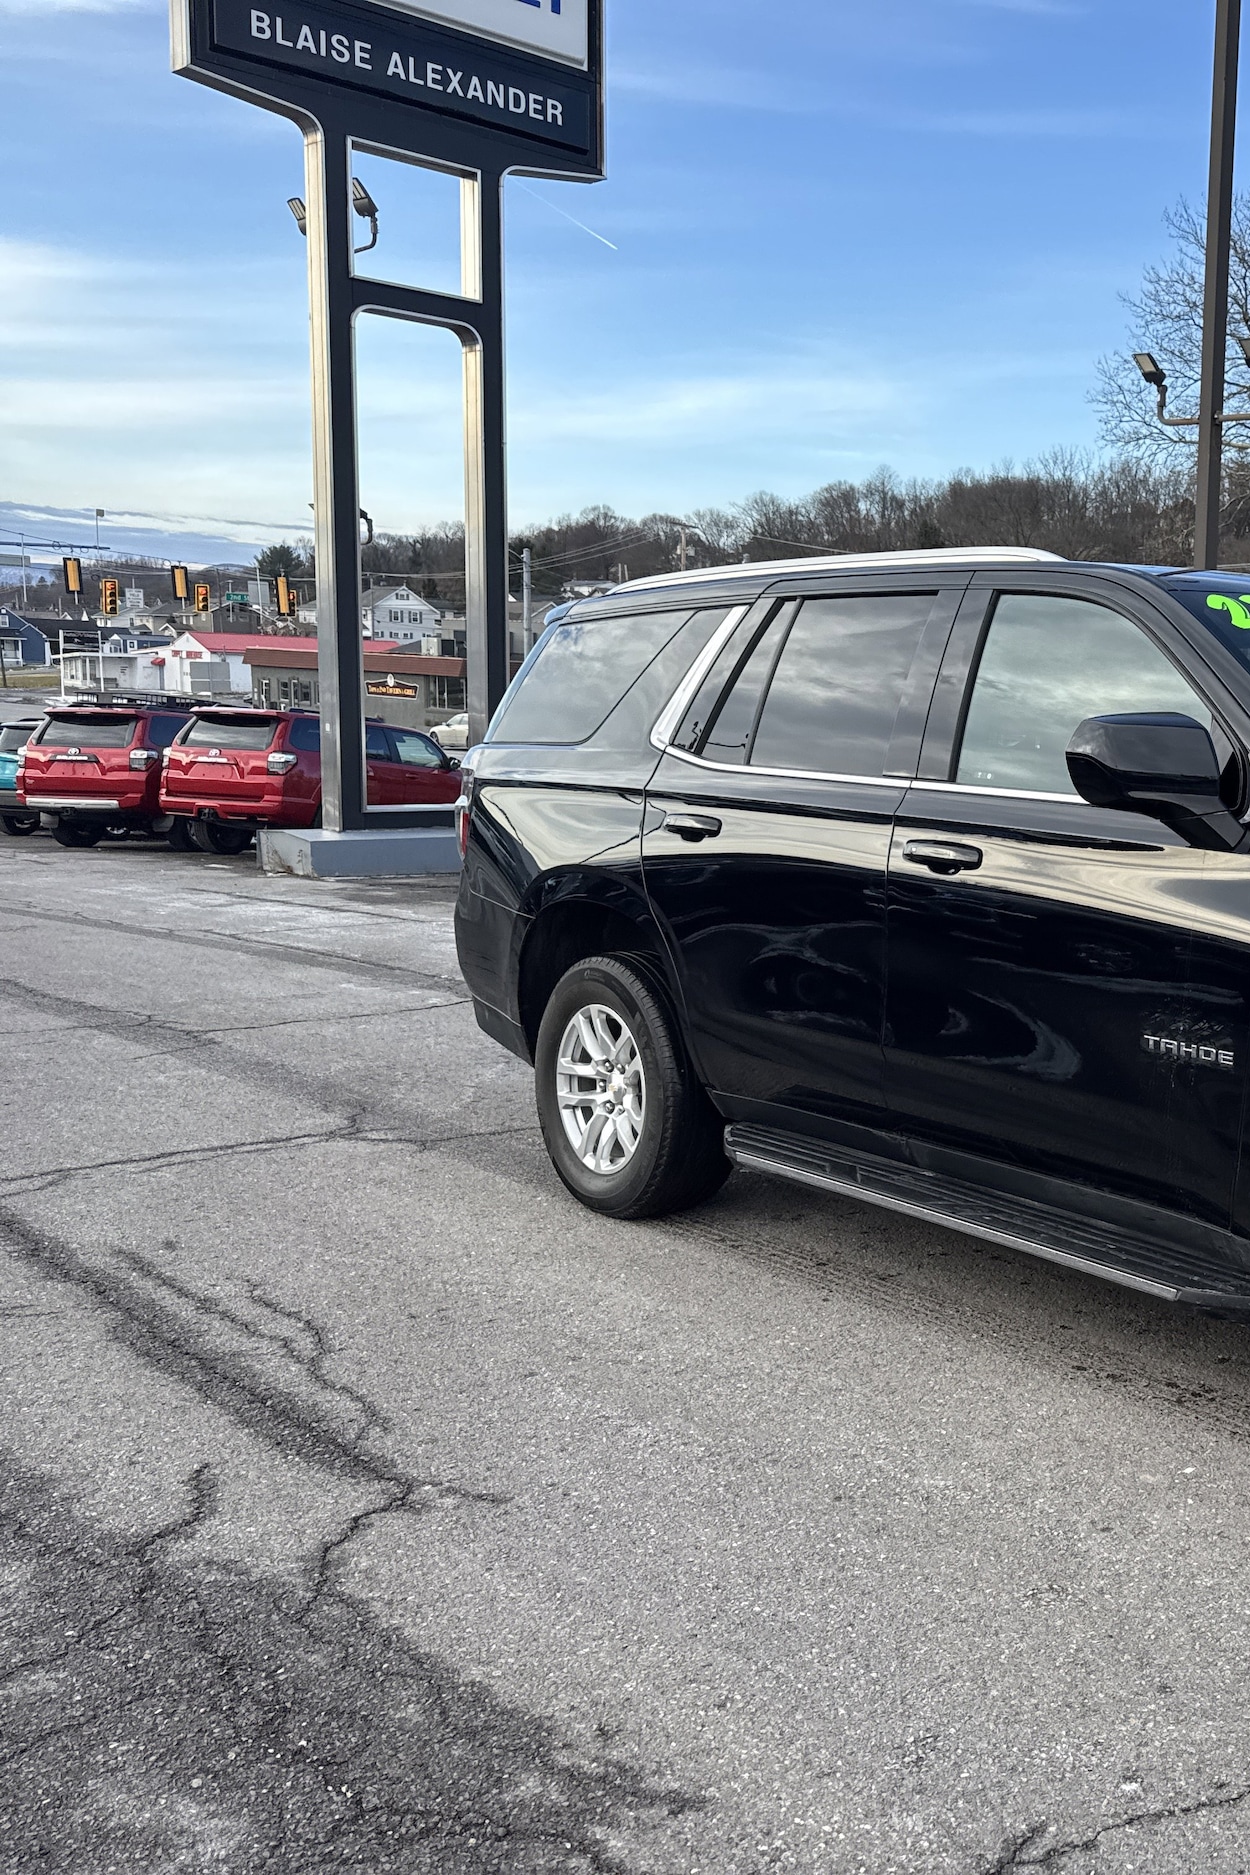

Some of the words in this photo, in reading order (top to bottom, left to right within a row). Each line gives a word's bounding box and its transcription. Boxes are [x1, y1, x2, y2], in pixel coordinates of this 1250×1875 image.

[250, 9, 373, 71] BLAISE
[386, 51, 563, 127] ALEXANDER
[1143, 1034, 1235, 1066] TAHOE
